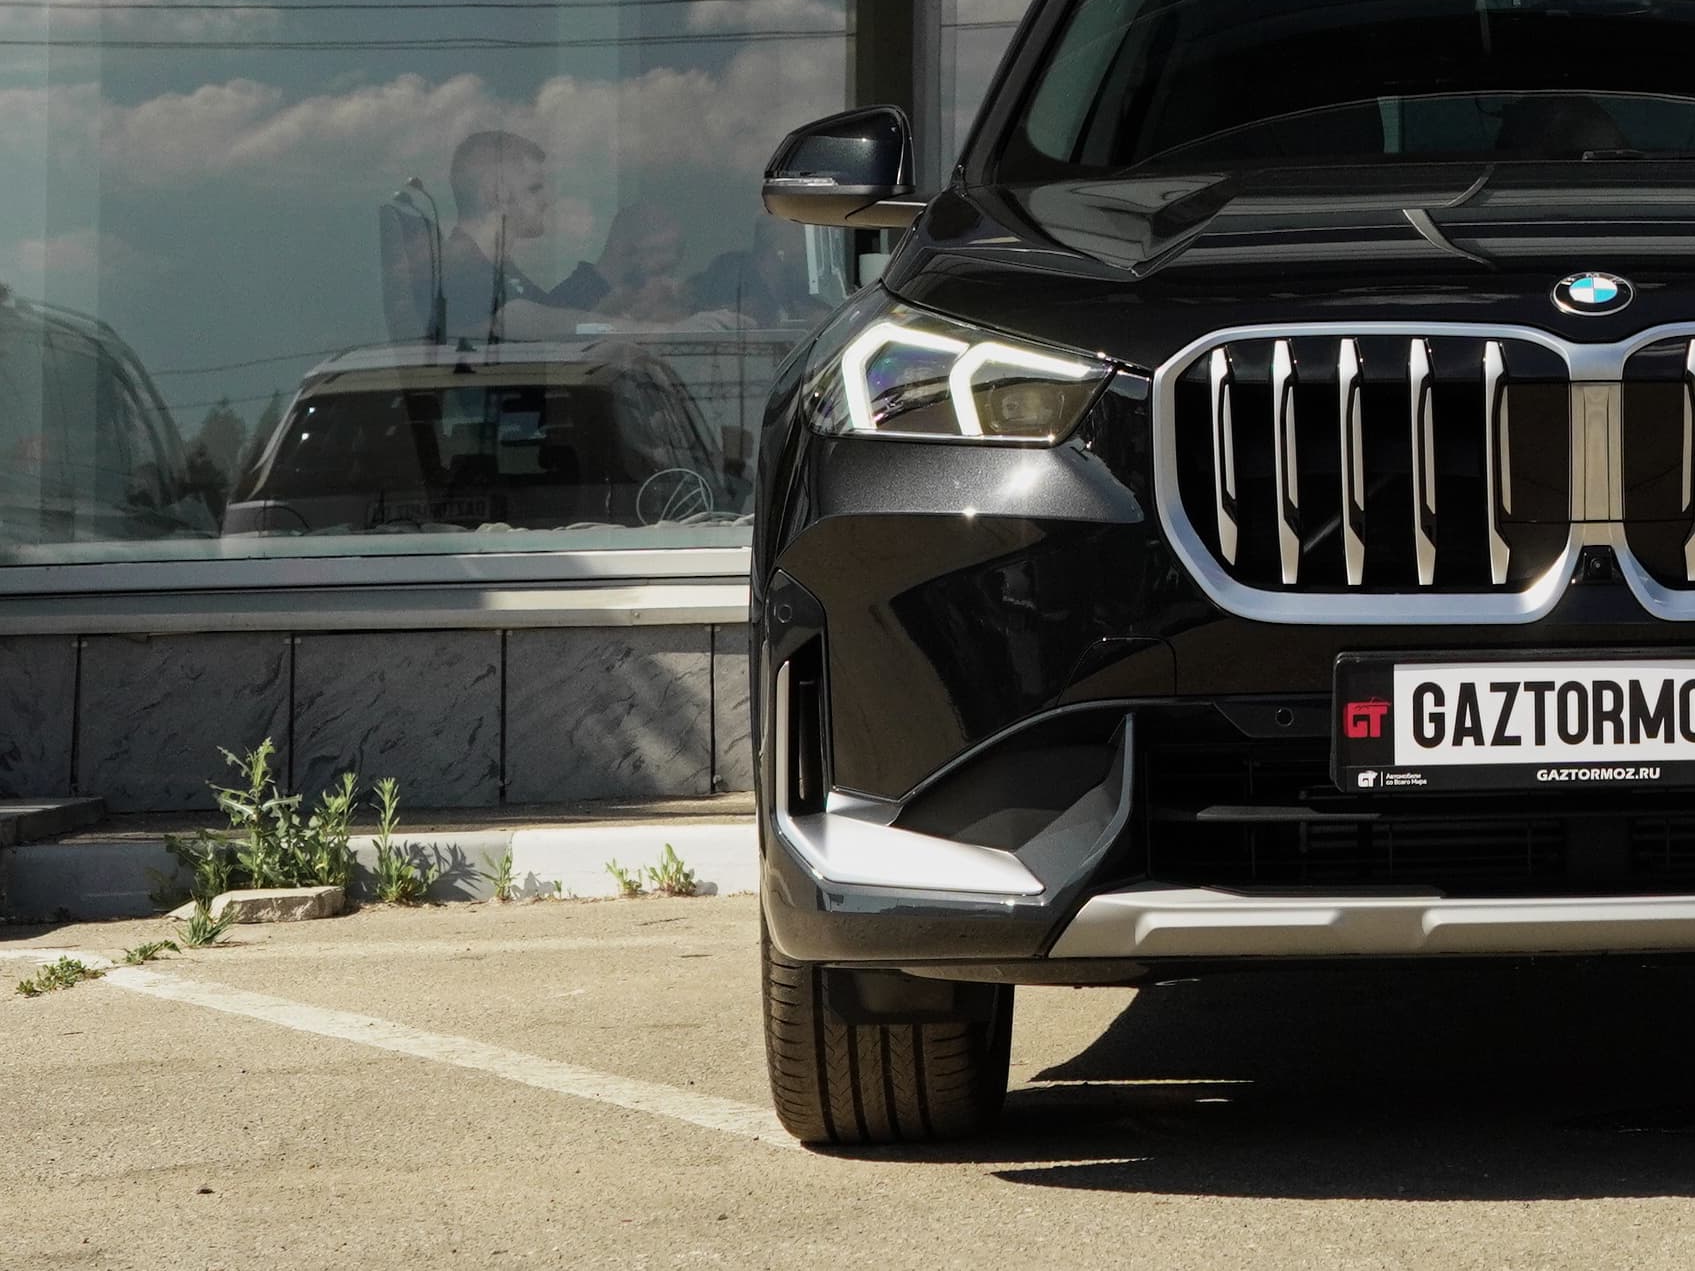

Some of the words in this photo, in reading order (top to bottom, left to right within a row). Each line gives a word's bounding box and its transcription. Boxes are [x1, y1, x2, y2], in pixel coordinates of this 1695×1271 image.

[1343, 700, 1390, 739] GT
[1358, 771, 1378, 788] GT
[1536, 767, 1661, 782] GAZTORMOZ.RU
